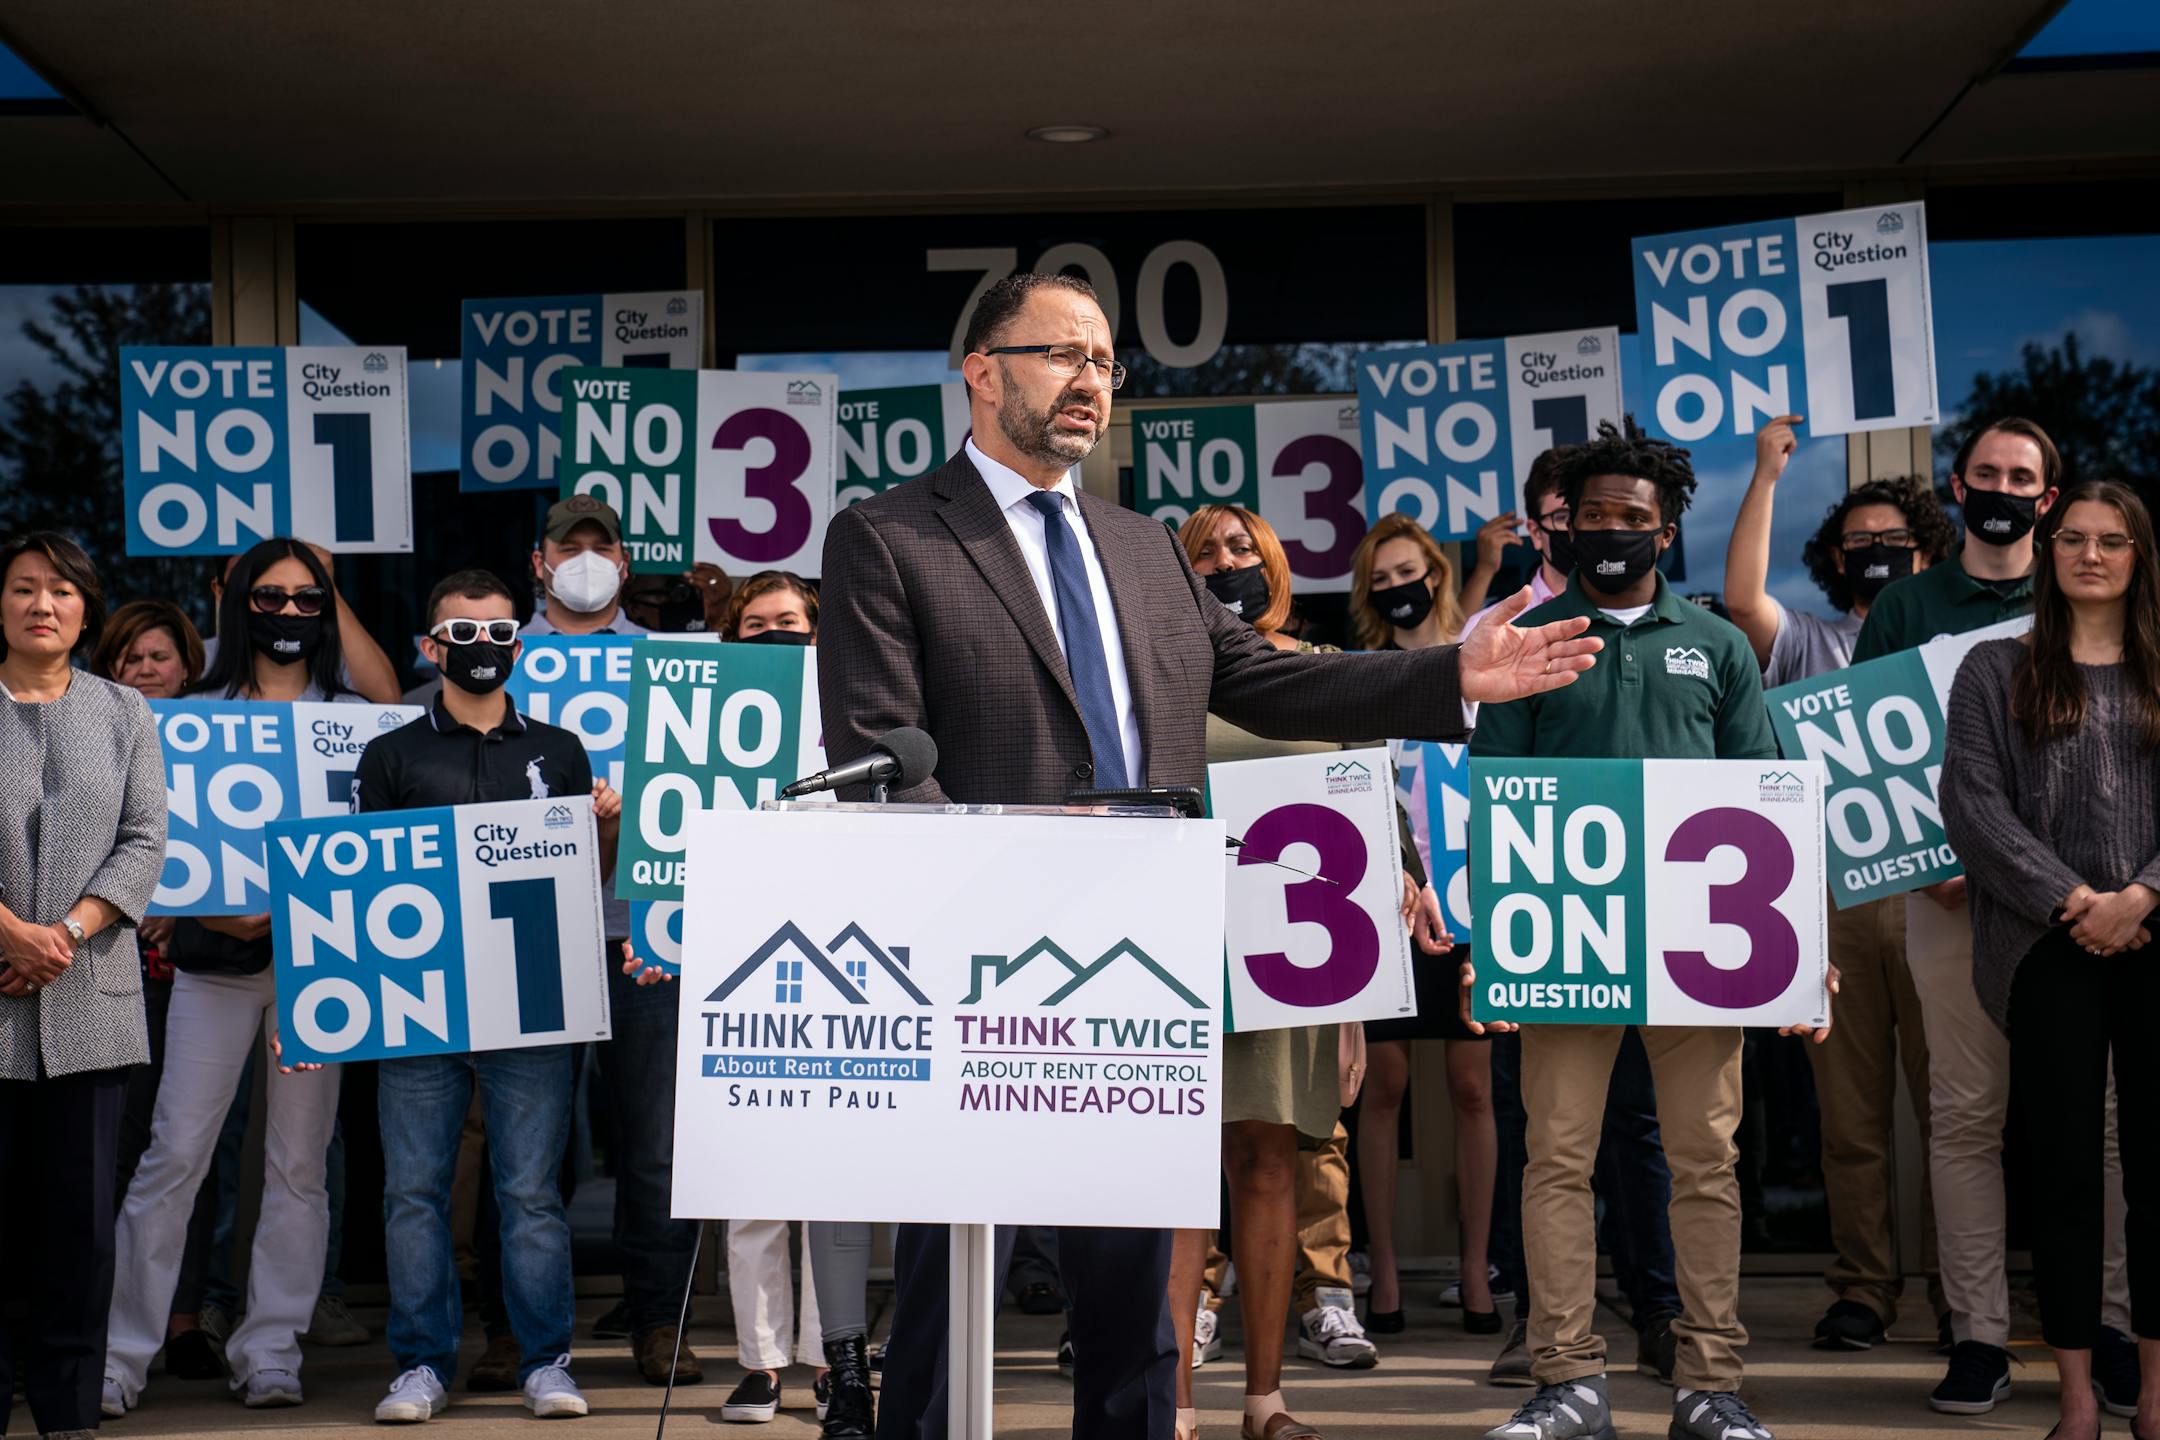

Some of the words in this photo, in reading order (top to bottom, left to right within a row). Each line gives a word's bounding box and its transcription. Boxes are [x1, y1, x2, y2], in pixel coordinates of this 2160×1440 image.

[1643, 235, 1785, 288] VOTE
[1813, 231, 1853, 251] City
[1815, 243, 1907, 270] Question
[472, 309, 592, 347] VOTE
[615, 309, 648, 325] City
[615, 324, 688, 343] Question
[1652, 288, 1787, 366] NO
[1521, 352, 1557, 370] City
[1826, 278, 1896, 420] 1
[130, 360, 274, 398] VOTE
[302, 363, 341, 382] City
[303, 381, 390, 401] Question
[573, 380, 631, 400] VOTE
[1366, 354, 1496, 398] VOTE
[1522, 365, 1604, 387] Question
[837, 401, 880, 421] OTE
[1656, 365, 1790, 441] ON
[138, 408, 274, 473] NO
[575, 402, 683, 467] NO
[837, 418, 932, 480] NO
[1141, 420, 1194, 439] VOTE
[1374, 401, 1497, 469] NO
[313, 413, 375, 543] 1
[708, 407, 812, 563] 3
[1146, 438, 1244, 500] NO
[138, 483, 274, 548] ON
[1272, 434, 1367, 580] 3
[1378, 470, 1500, 534] ON
[645, 658, 718, 683] VOTE
[1782, 684, 1853, 720] VOTE
[156, 713, 282, 753] OTE
[312, 720, 353, 738] City
[645, 686, 782, 768] NO
[1795, 695, 1931, 786] NO
[1485, 776, 1558, 800] VOTE
[1826, 764, 1944, 858] ON
[278, 824, 442, 879] VOTE
[474, 824, 518, 844] City
[476, 841, 577, 867] Question
[1490, 804, 1626, 886] NO
[1843, 843, 1959, 891] QUESTIO
[288, 883, 444, 967] NO
[1237, 803, 1380, 1007] 3
[1663, 806, 1800, 1009] 3
[1490, 892, 1626, 975] ON
[489, 877, 565, 1034] 1
[293, 969, 449, 1053] ON
[1488, 983, 1632, 1009] QUESTION
[701, 1012, 813, 1049] THINK
[822, 1015, 933, 1051] TWICE
[954, 1015, 1076, 1046] THINK
[1085, 1018, 1209, 1049] TWICE
[713, 1057, 777, 1075] About
[785, 1058, 832, 1076] Rent
[840, 1059, 918, 1077] Control
[961, 1061, 1037, 1079] ABOUT
[1043, 1062, 1097, 1080] RENT
[1103, 1064, 1207, 1082] CONTROL
[728, 1084, 811, 1107] SAINT
[829, 1086, 897, 1109] PAUL
[959, 1083, 1205, 1116] MINNEAPOLIS
